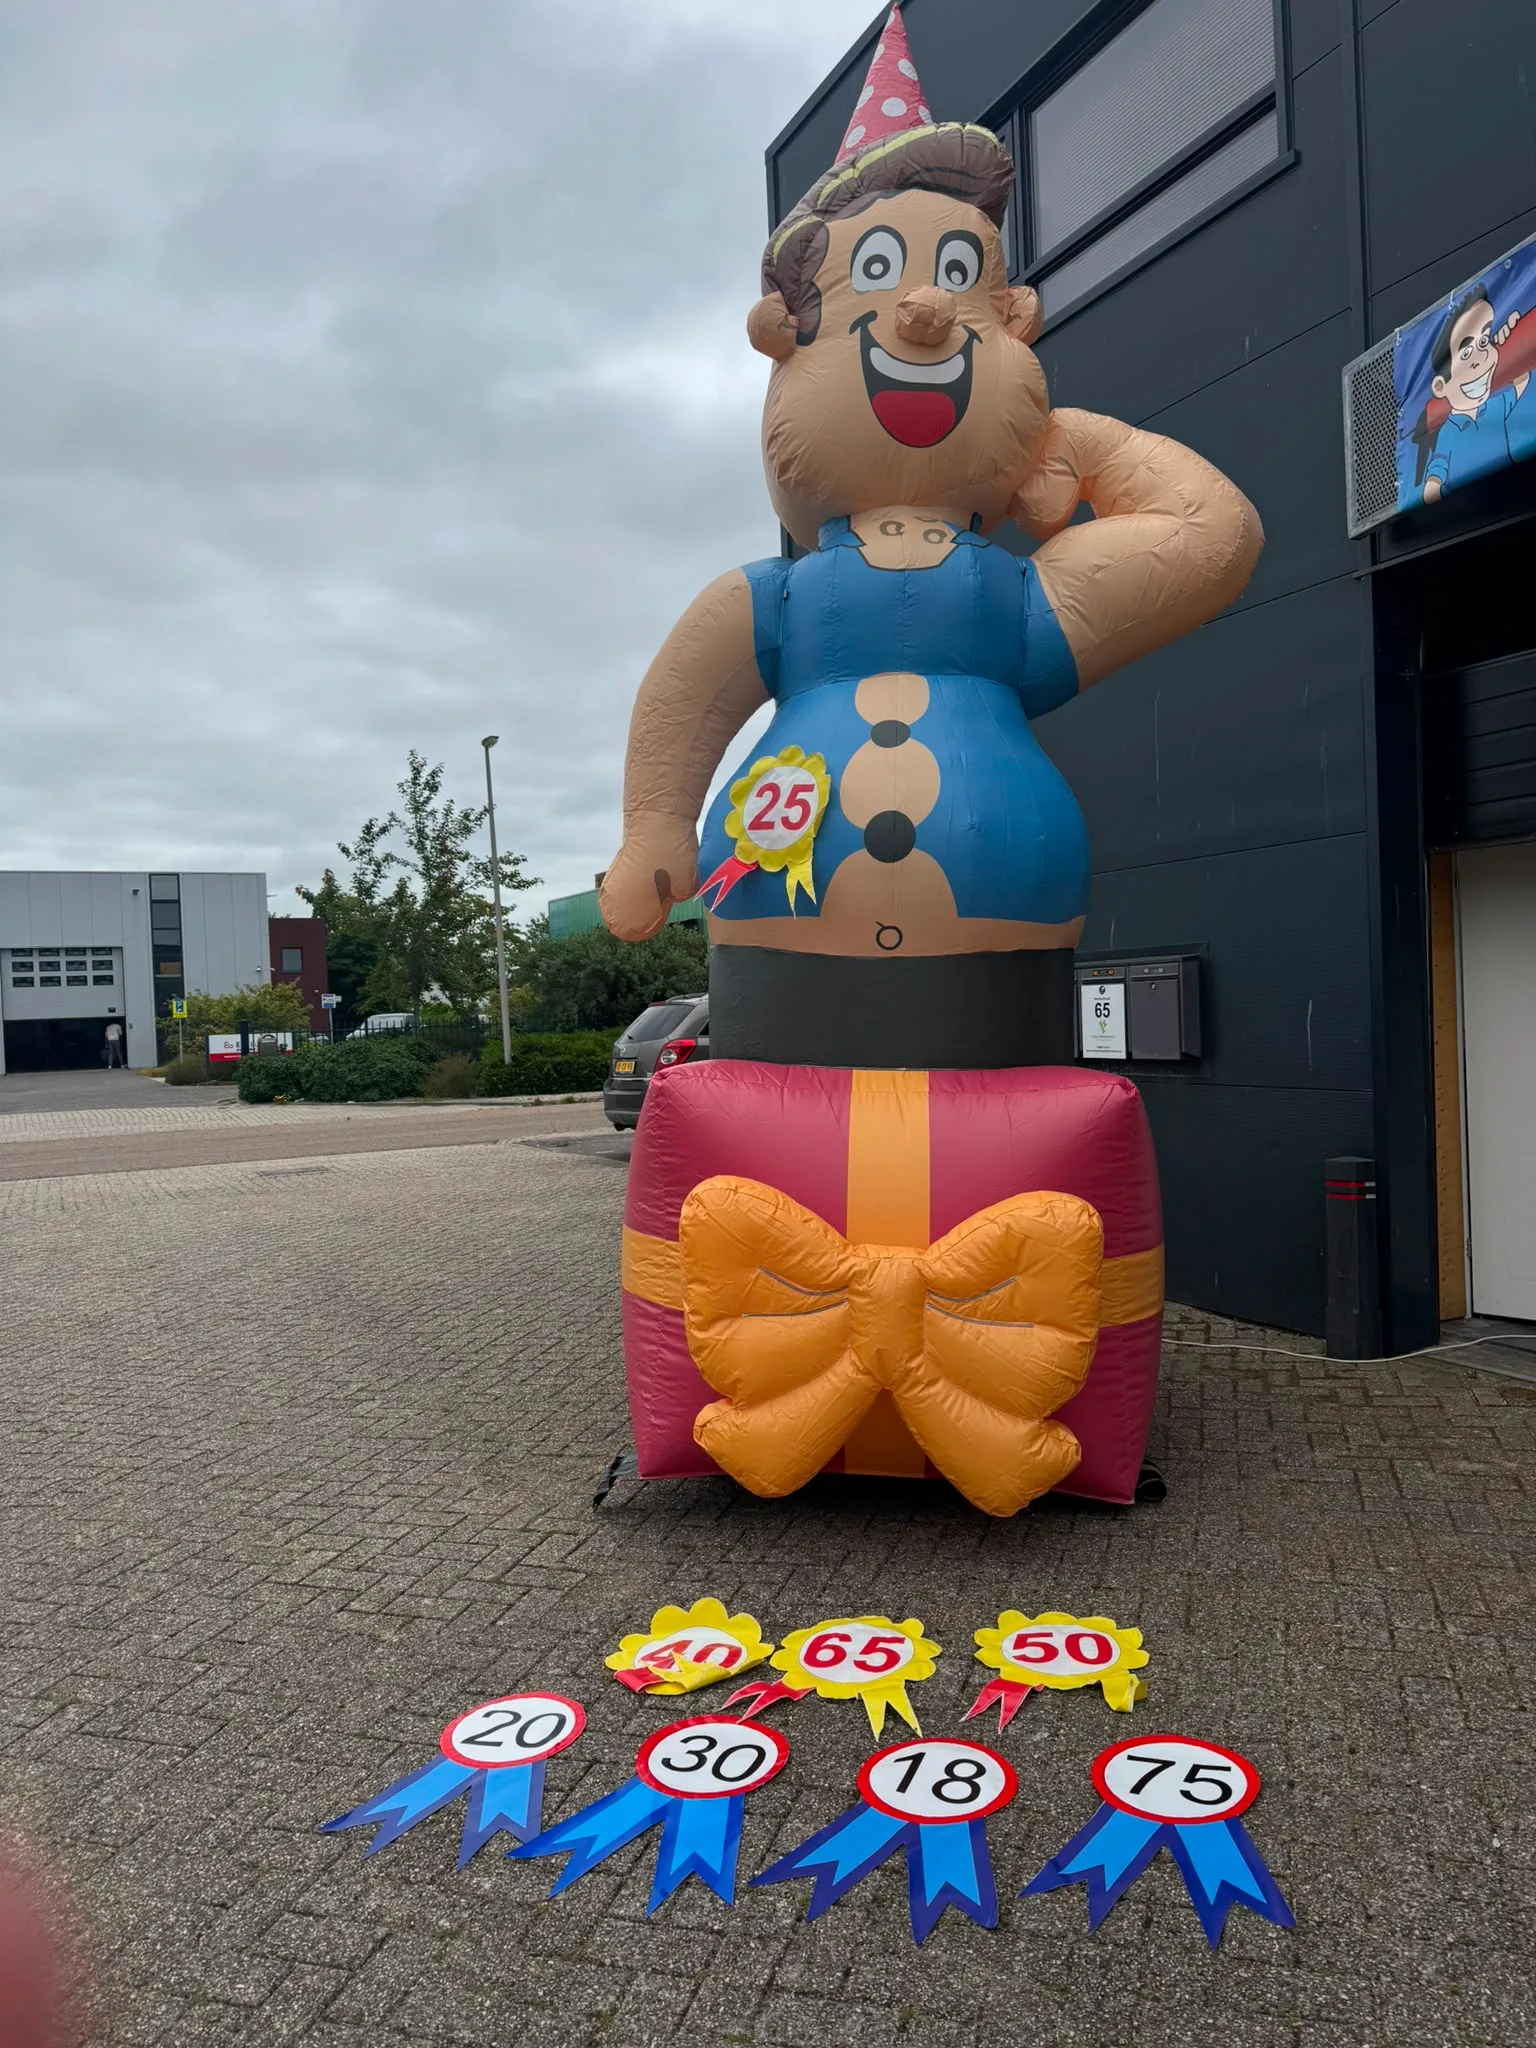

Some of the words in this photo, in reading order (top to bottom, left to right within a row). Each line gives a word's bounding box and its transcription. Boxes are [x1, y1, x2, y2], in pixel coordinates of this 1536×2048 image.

[747, 782, 815, 831] 25
[1094, 1002, 1110, 1018] 65
[802, 1632, 906, 1673] 65
[1012, 1632, 1113, 1665] 50
[461, 1709, 567, 1748] 20
[661, 1735, 767, 1783] 30
[894, 1752, 987, 1804] 18
[1126, 1754, 1233, 1806] 75
